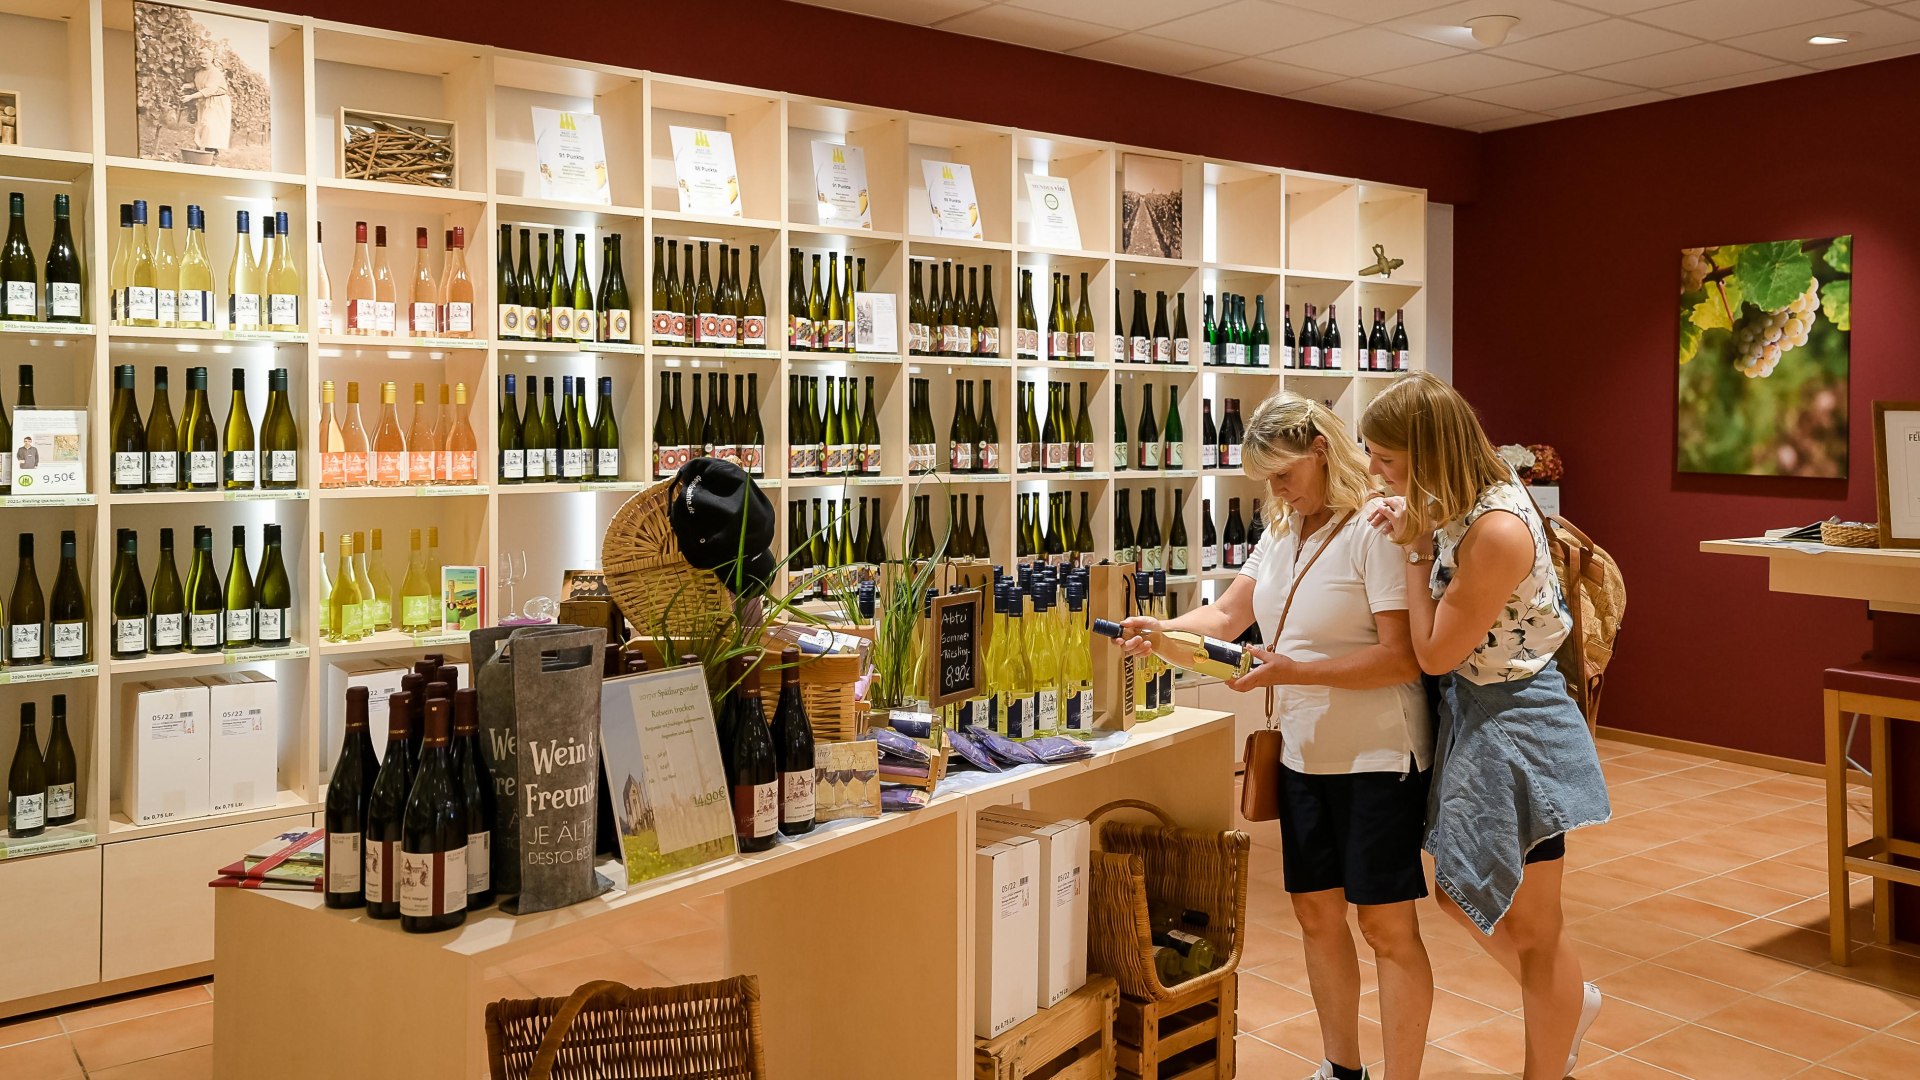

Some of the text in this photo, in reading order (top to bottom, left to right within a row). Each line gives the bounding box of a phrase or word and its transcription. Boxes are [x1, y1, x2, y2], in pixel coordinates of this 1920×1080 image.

[42, 472, 76, 484] 9,50€
[941, 608, 967, 624] Abtei
[657, 683, 698, 698] Spätburgunder
[651, 704, 695, 718] Rotwein trocken
[529, 736, 586, 775] Wein
[490, 768, 516, 796] re
[525, 772, 595, 818] Freund
[693, 786, 726, 806] 14,90€
[979, 816, 1018, 826] Vorsicht
[528, 826, 549, 845] JE
[529, 850, 573, 864] DESTO
[1058, 871, 1070, 882] 05/22
[1002, 882, 1016, 893] 05/22
